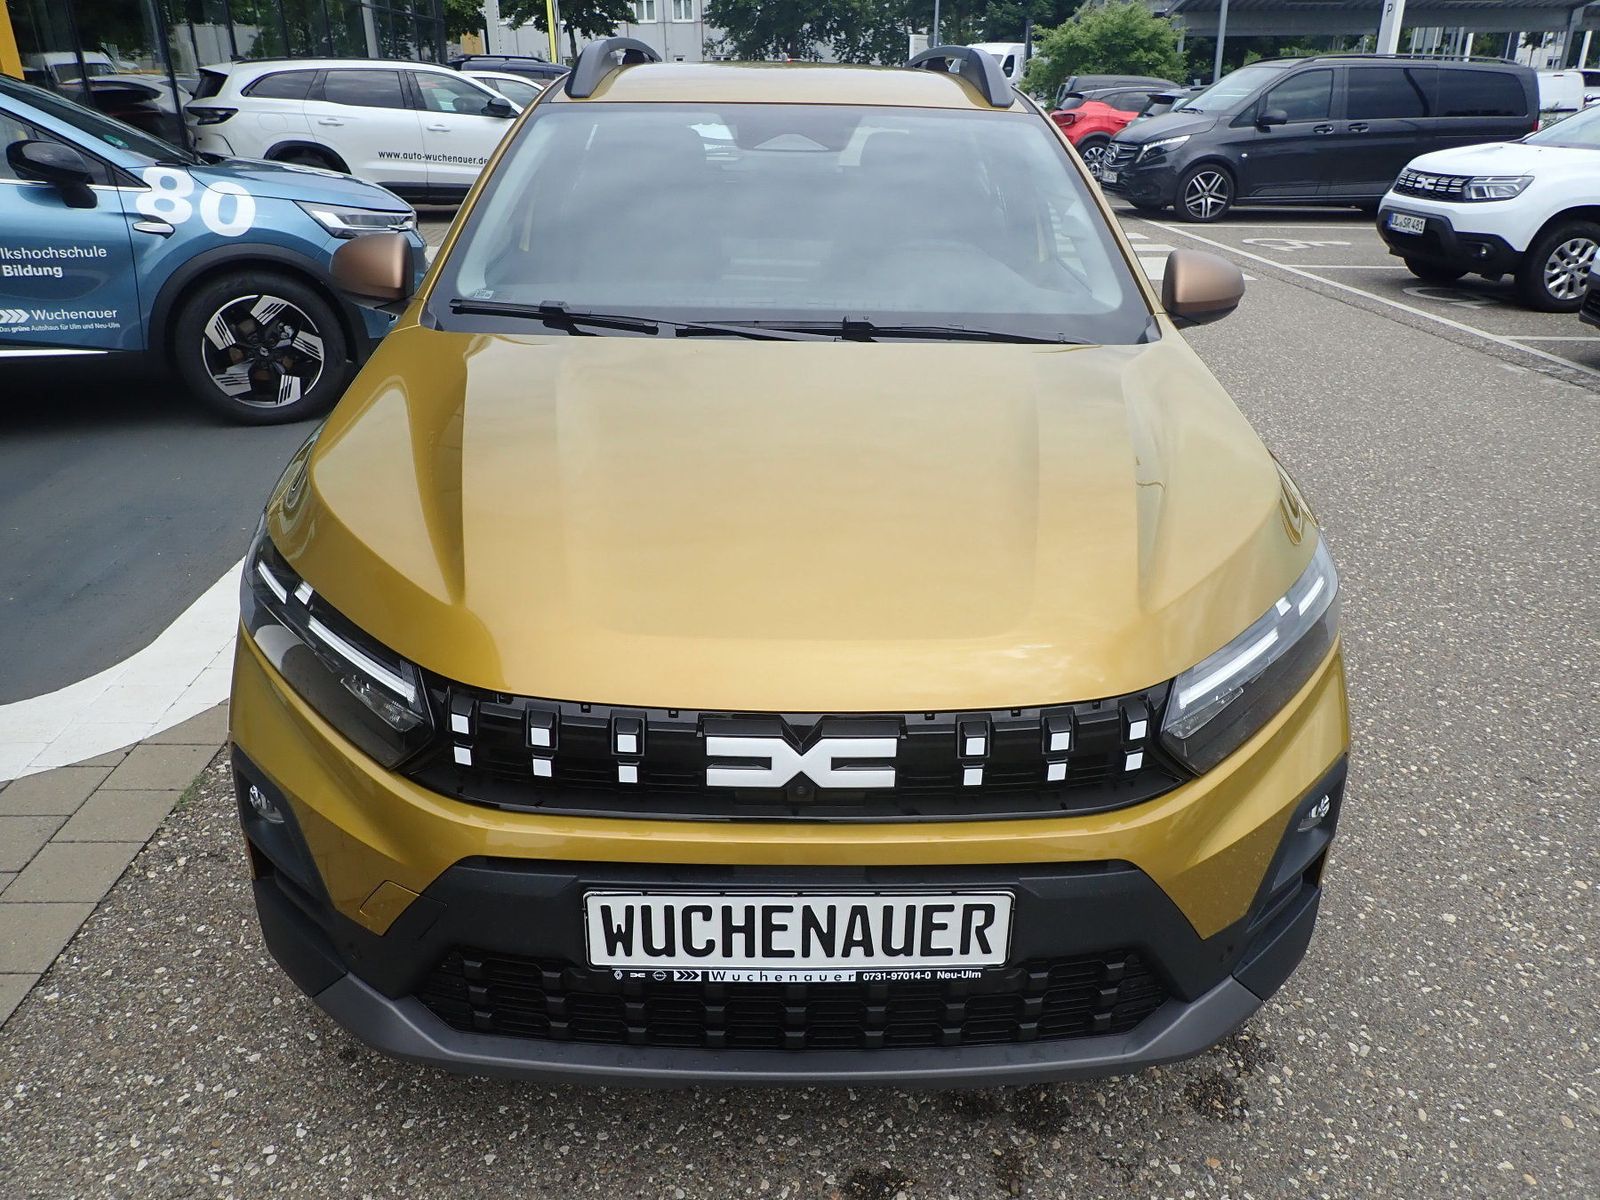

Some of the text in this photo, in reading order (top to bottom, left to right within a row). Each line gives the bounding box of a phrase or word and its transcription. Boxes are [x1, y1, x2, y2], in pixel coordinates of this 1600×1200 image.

[1386, 3, 1393, 16] P
[136, 166, 256, 237] 80
[0, 246, 107, 260] lkshochschule
[2, 264, 63, 278] Bildung
[31, 309, 118, 320] Wuchenauer
[12, 325, 30, 334] grüne
[70, 322, 82, 330] Ulm
[83, 322, 94, 330] und
[95, 321, 121, 329] Neu-Ulm
[600, 903, 996, 958] WUCHENAUER
[711, 970, 982, 982] Wuchenauer 0731-97014-0 Neu-Ulm
